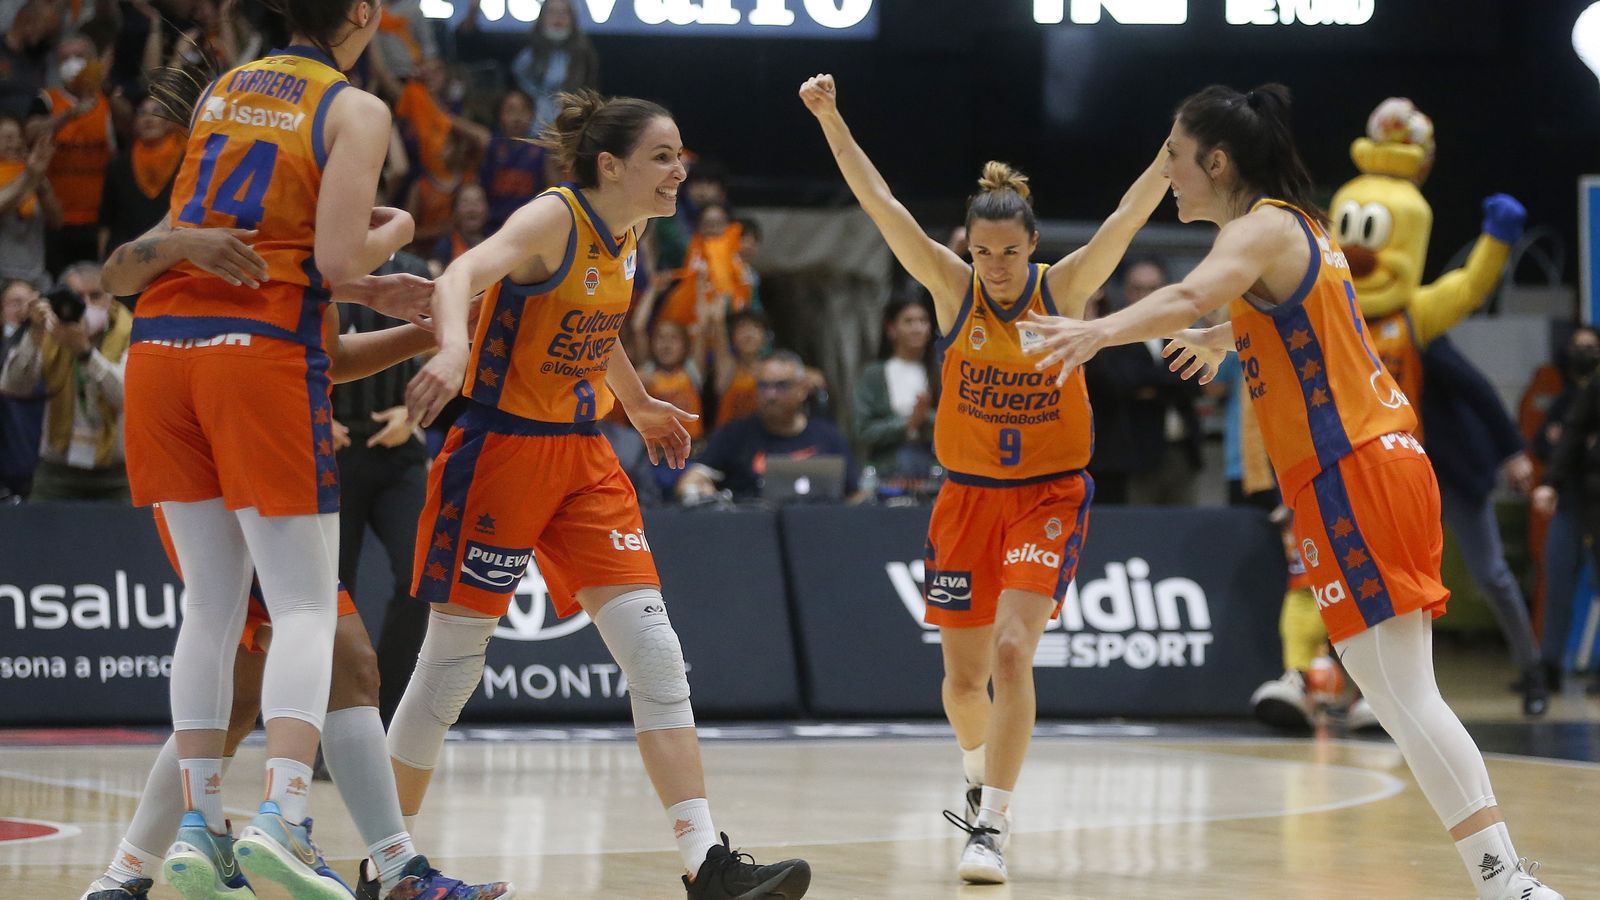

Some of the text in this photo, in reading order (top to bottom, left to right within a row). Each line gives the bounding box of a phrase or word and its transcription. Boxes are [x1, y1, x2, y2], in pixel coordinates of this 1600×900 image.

[228, 99, 306, 132] isaval
[178, 132, 279, 230] 14
[960, 360, 1043, 387] Cultura
[574, 379, 596, 422] 8
[959, 380, 1061, 411] Esfuerzo
[957, 402, 1061, 425] @ValenciaBasket
[999, 428, 1021, 466] 9
[609, 527, 650, 552] tei
[1003, 542, 1060, 569] eika
[467, 546, 529, 568] PULEVA
[0, 570, 186, 630] nsalu
[1070, 631, 1214, 669] SPORT
[74, 655, 92, 679] a
[483, 663, 634, 699] MONT
